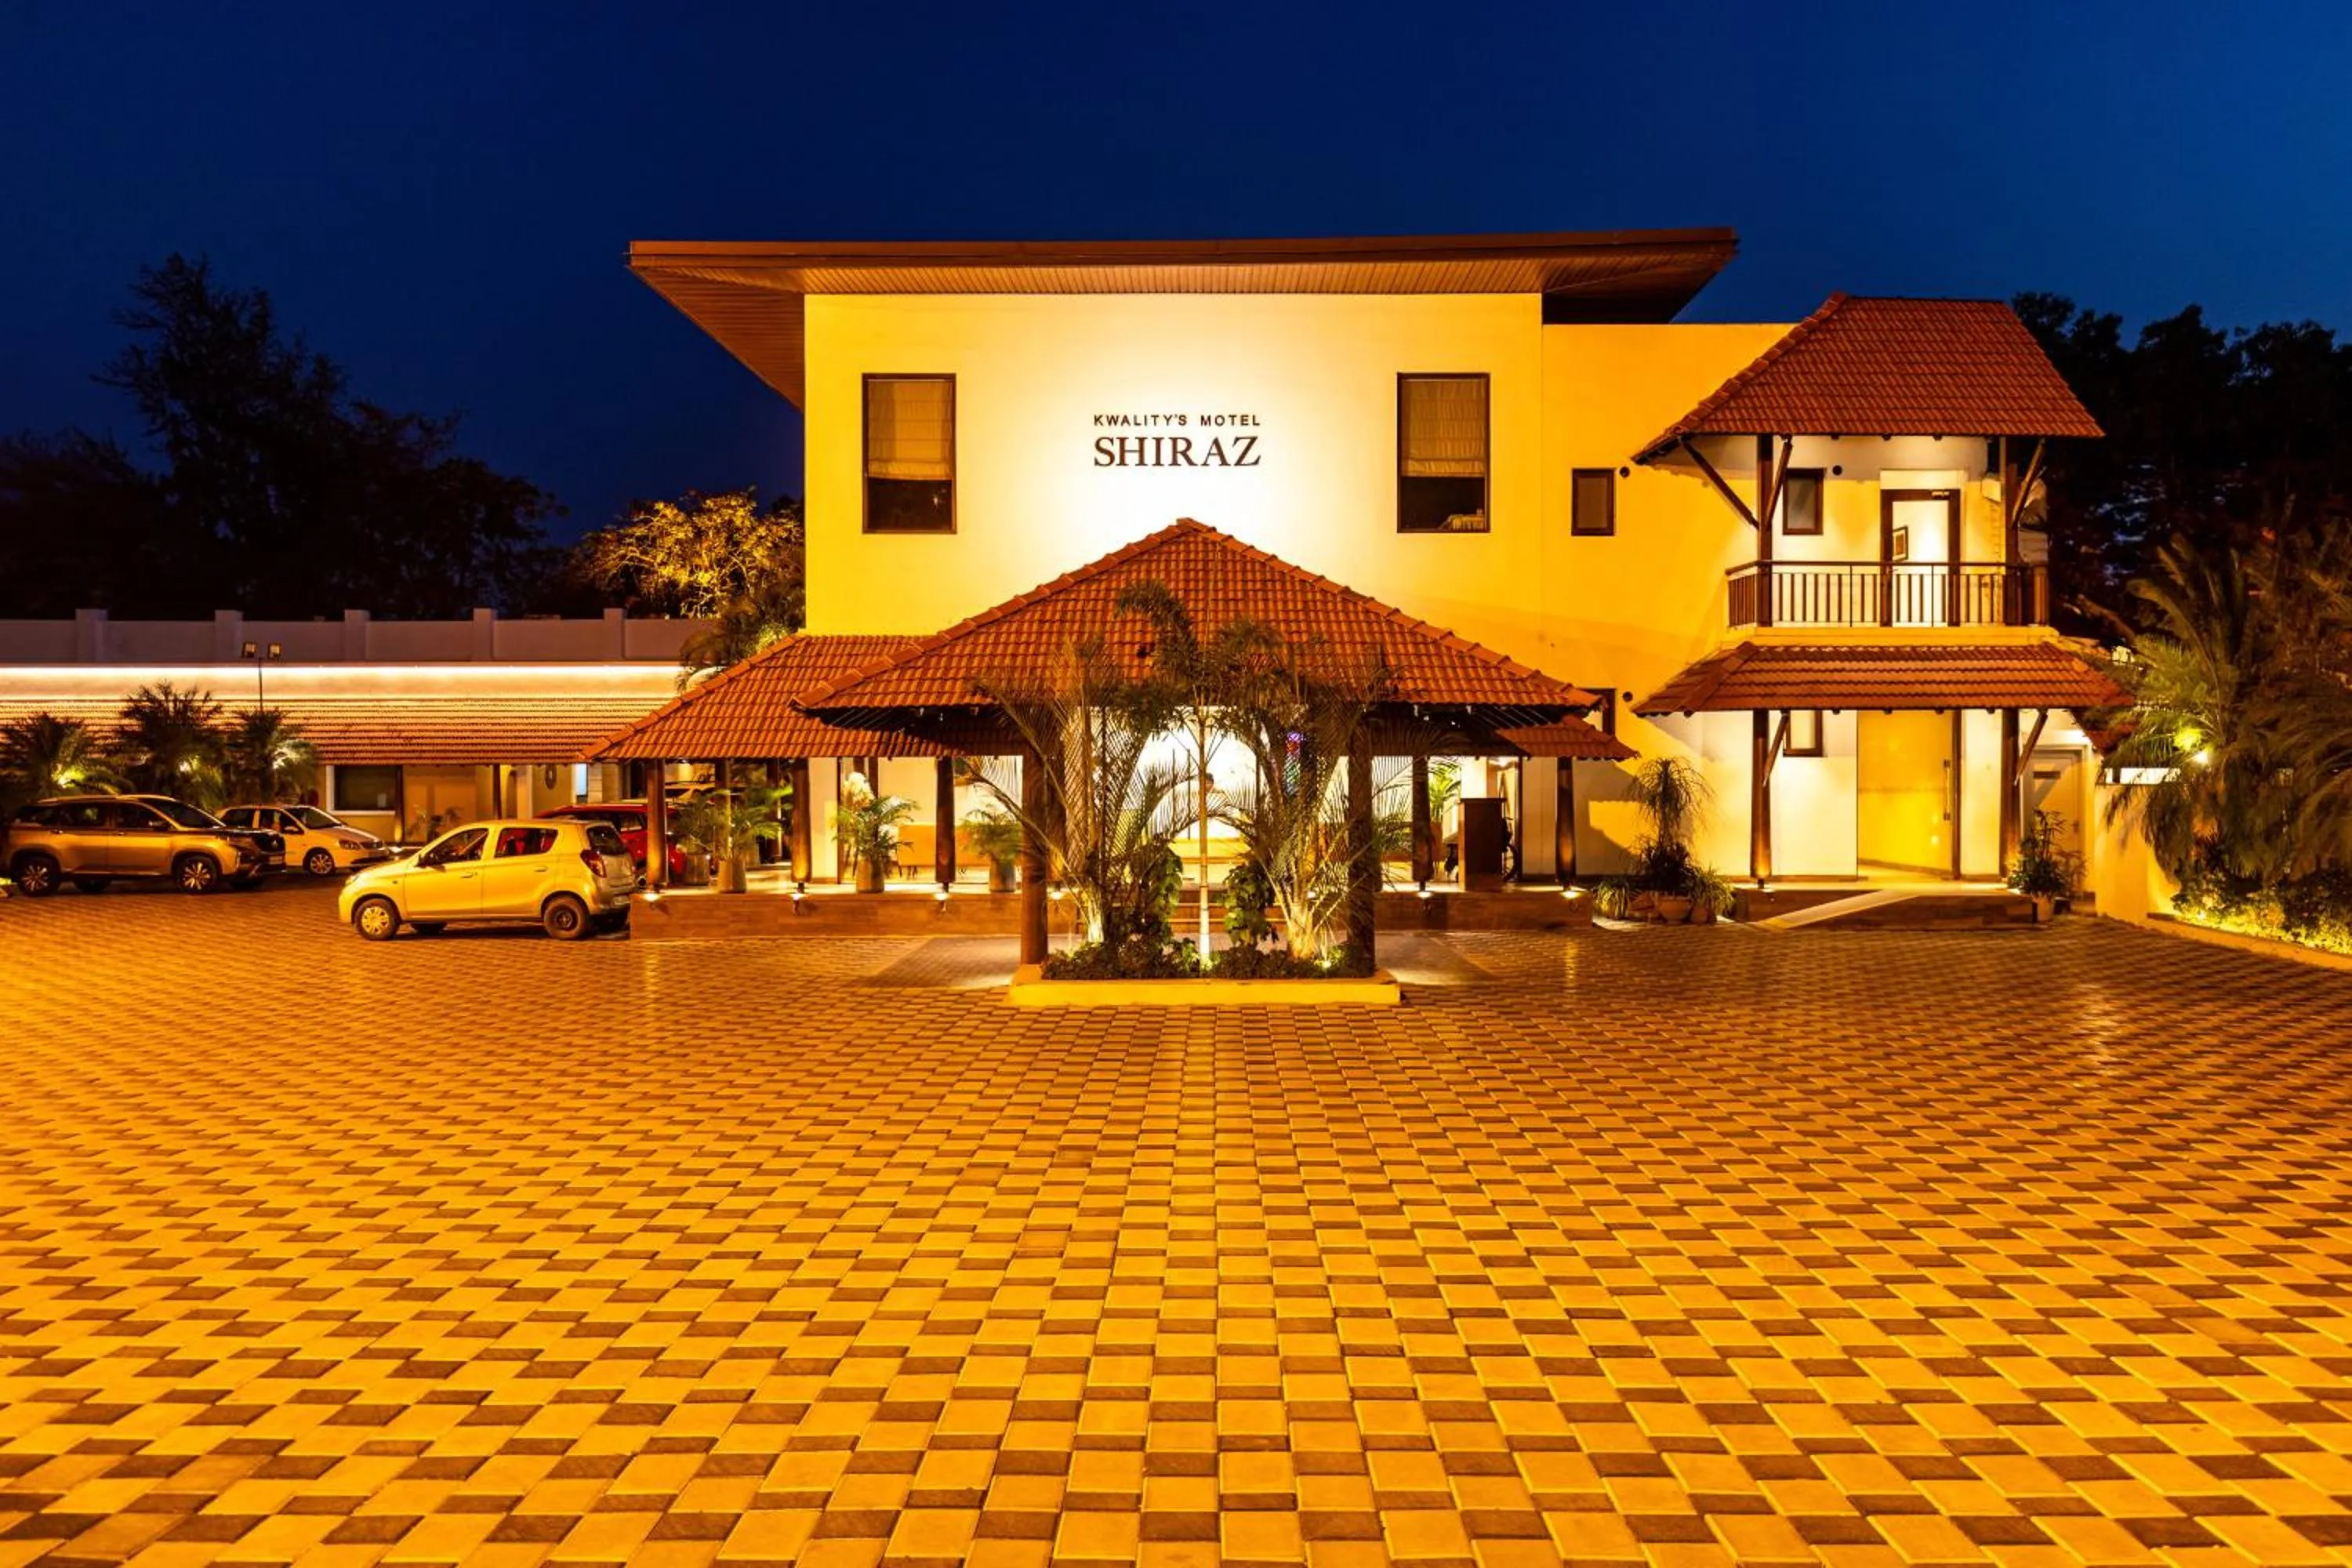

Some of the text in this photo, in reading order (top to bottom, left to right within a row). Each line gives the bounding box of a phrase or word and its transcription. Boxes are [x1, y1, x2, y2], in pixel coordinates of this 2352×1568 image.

[1094, 414, 1261, 426] KWALITY'S MOTEL
[1094, 436, 1261, 467] SHIRAZ
